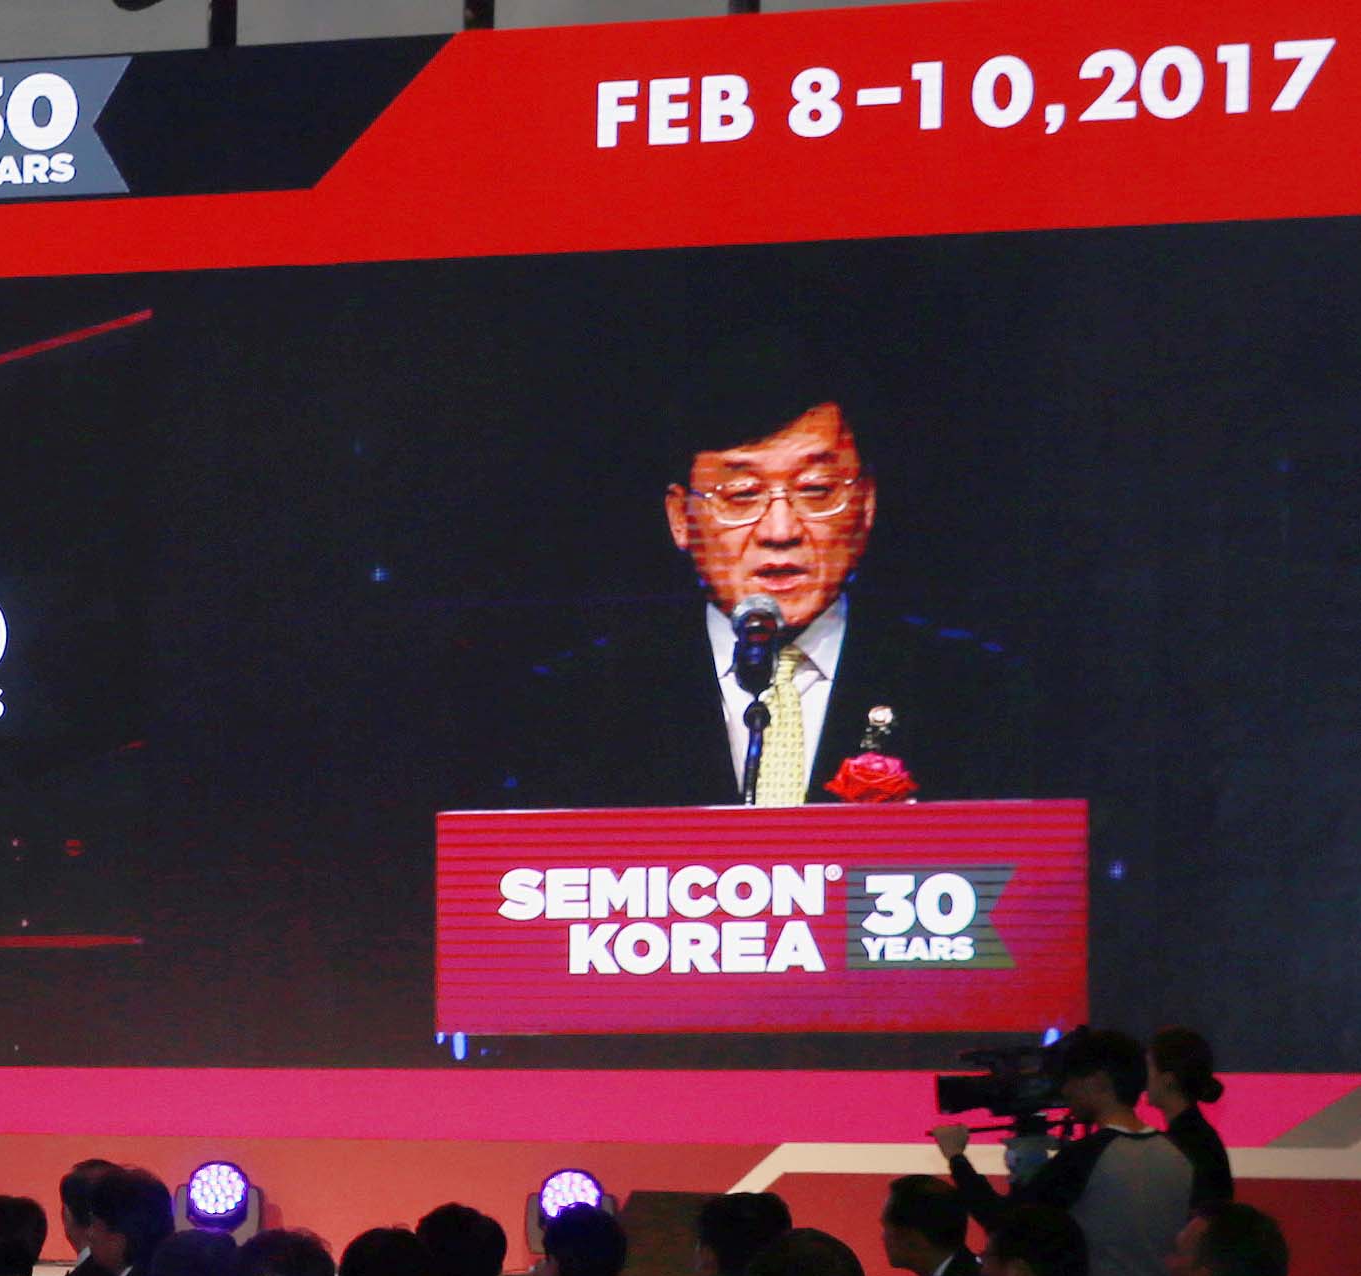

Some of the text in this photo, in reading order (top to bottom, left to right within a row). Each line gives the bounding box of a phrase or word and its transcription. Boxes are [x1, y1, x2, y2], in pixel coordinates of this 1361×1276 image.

[597, 74, 754, 148] FEB
[861, 872, 977, 935] 30
[568, 920, 826, 975] KOREA
[861, 935, 975, 962] YEARS
